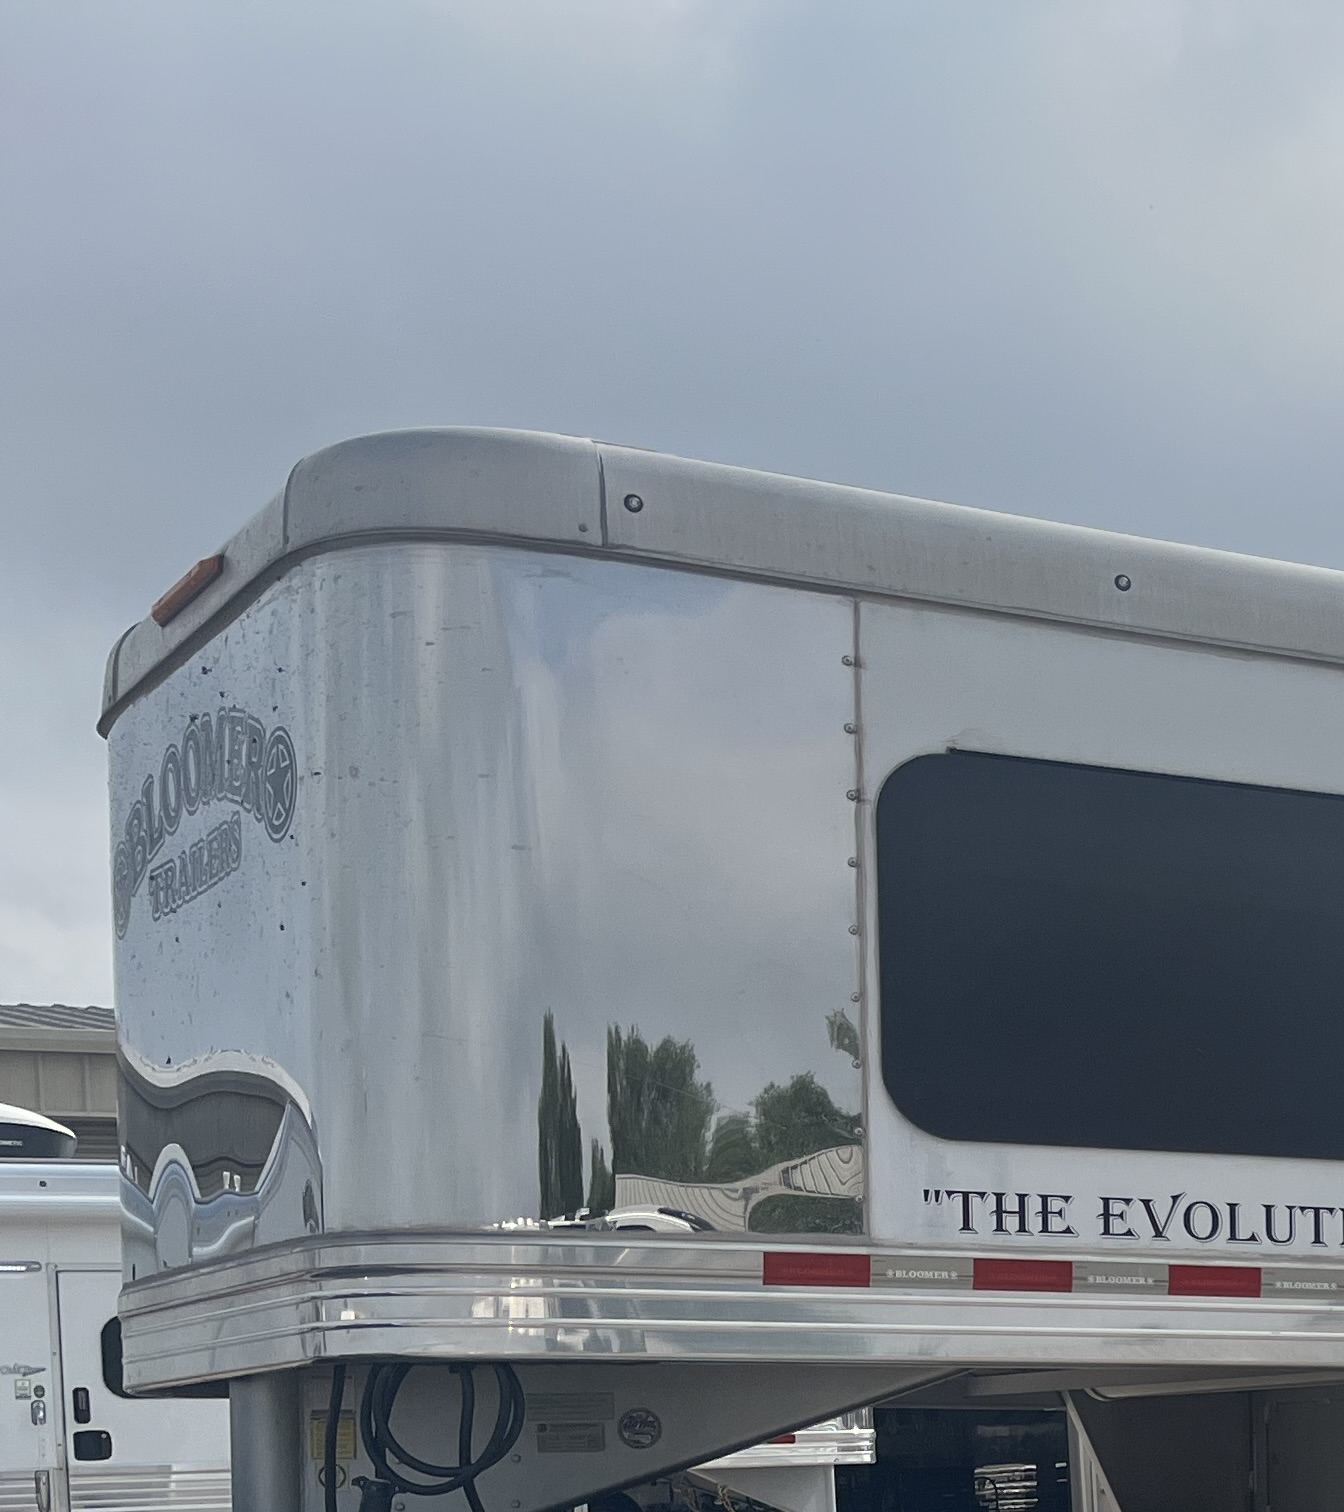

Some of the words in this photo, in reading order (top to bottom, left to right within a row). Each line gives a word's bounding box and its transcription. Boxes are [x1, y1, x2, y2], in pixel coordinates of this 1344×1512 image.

[125, 706, 266, 898] BLOOMER
[149, 810, 242, 922] TRAILERS
[923, 1189, 1080, 1238] "THE
[895, 1269, 949, 1279] BLOOMER
[1095, 1275, 1146, 1285] BLOOMER
[1282, 1281, 1330, 1290] BLOOMER
